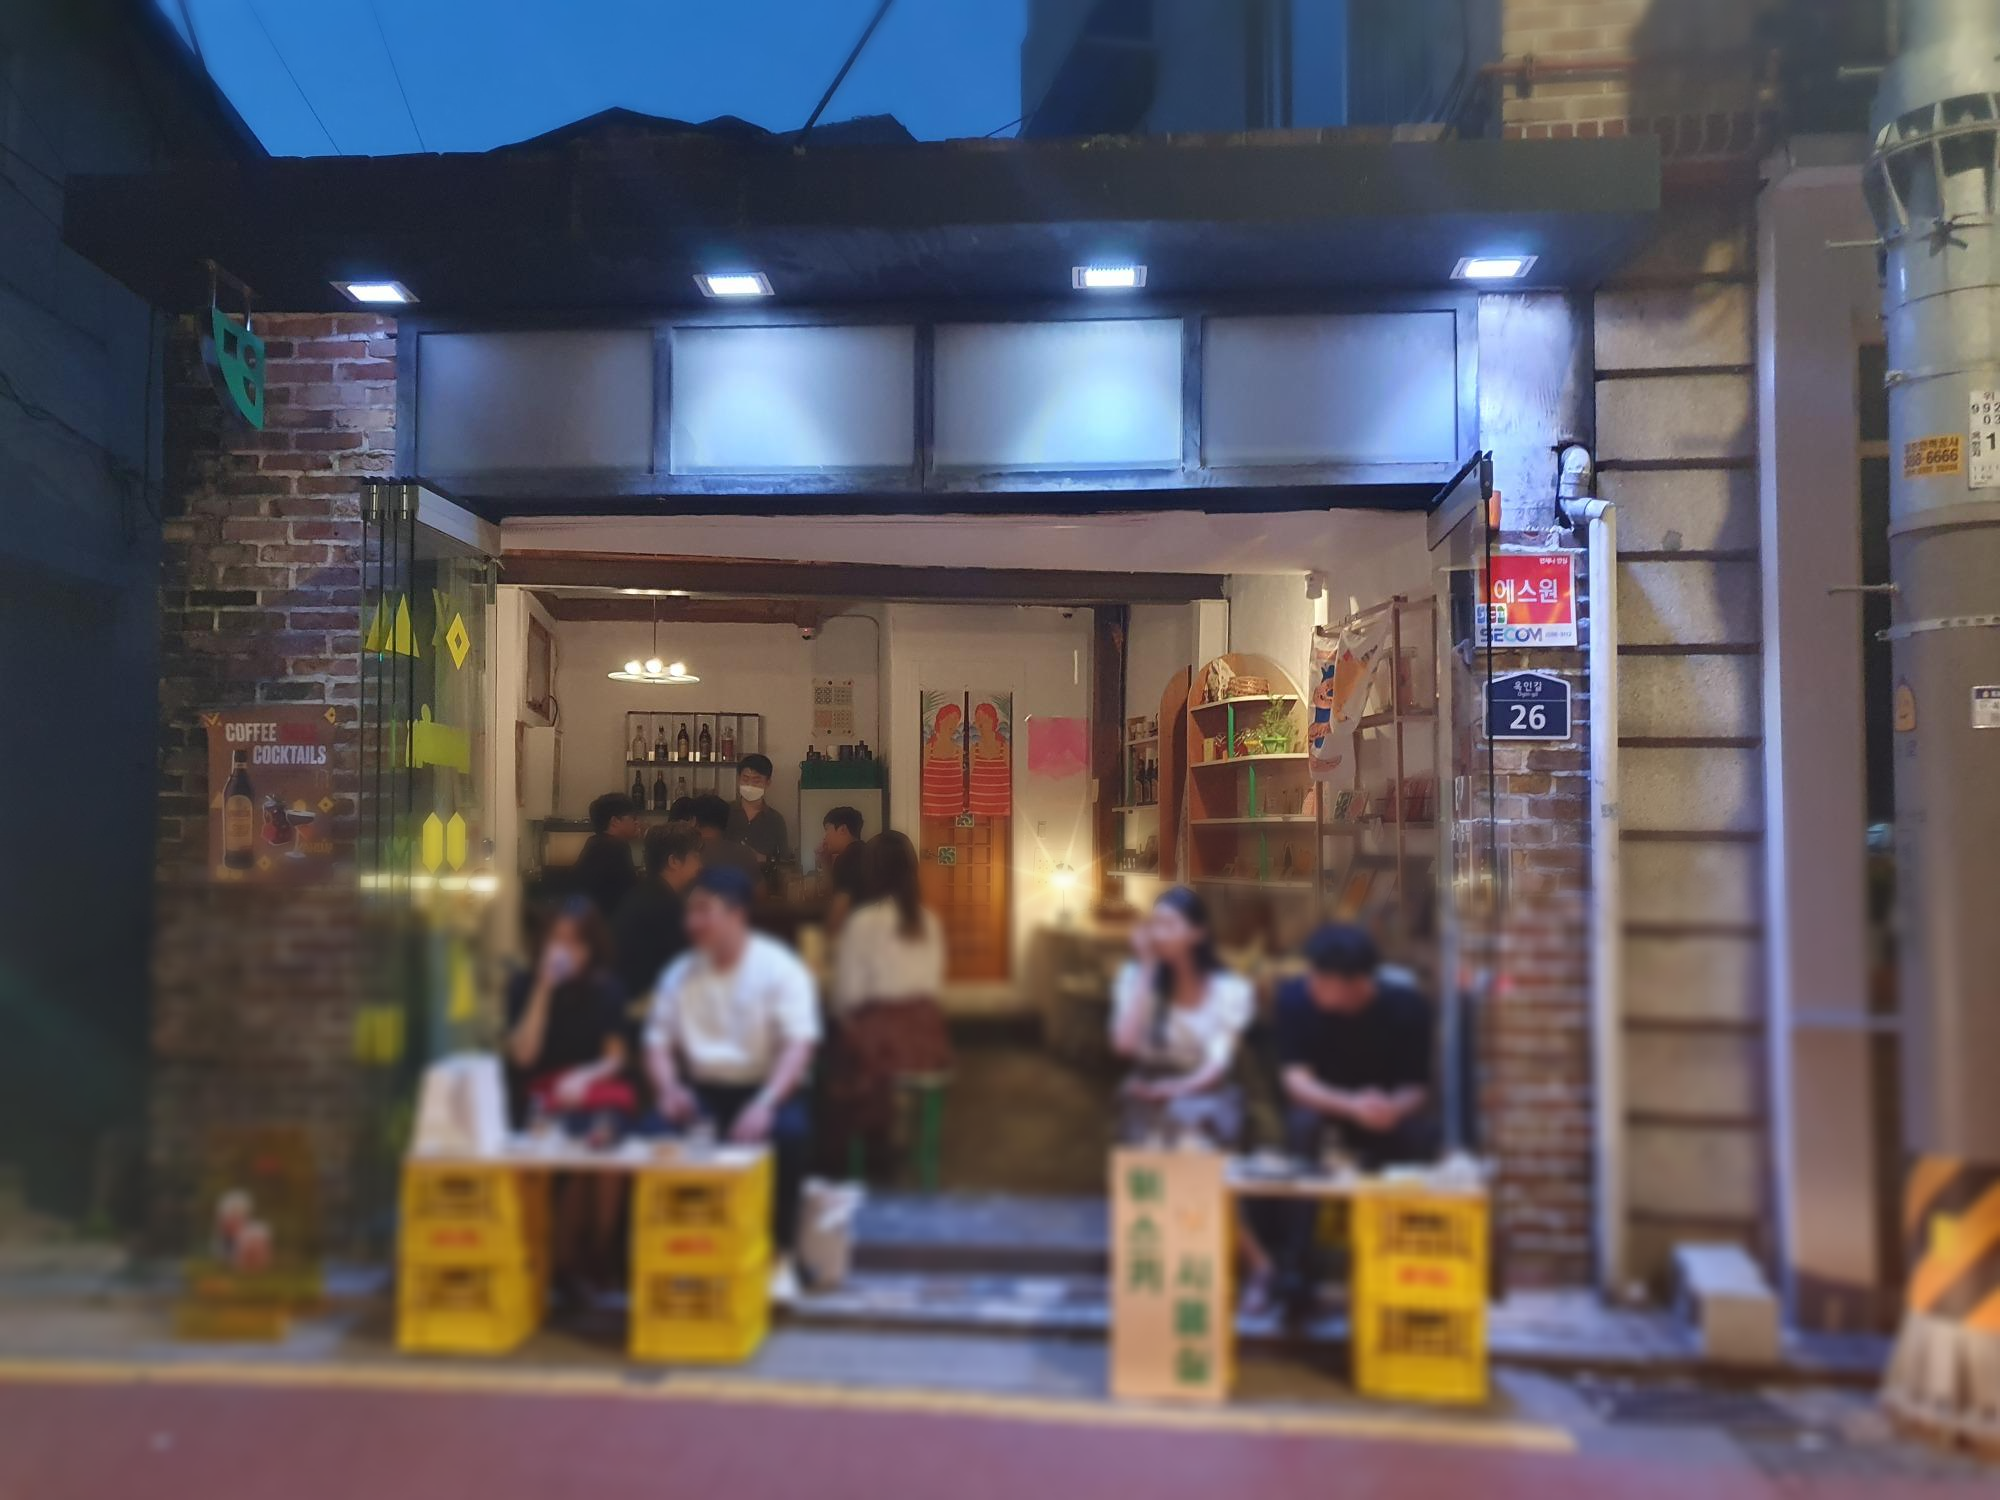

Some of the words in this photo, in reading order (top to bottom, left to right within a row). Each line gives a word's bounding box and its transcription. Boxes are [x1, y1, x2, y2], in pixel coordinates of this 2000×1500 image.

[1493, 577, 1558, 604] 에스원
[1479, 627, 1543, 643] SECOM
[1513, 680, 1542, 692] 옥인길
[1509, 704, 1546, 730] 26
[225, 722, 277, 742] COFFEE
[252, 745, 327, 765] COCKTAILS
